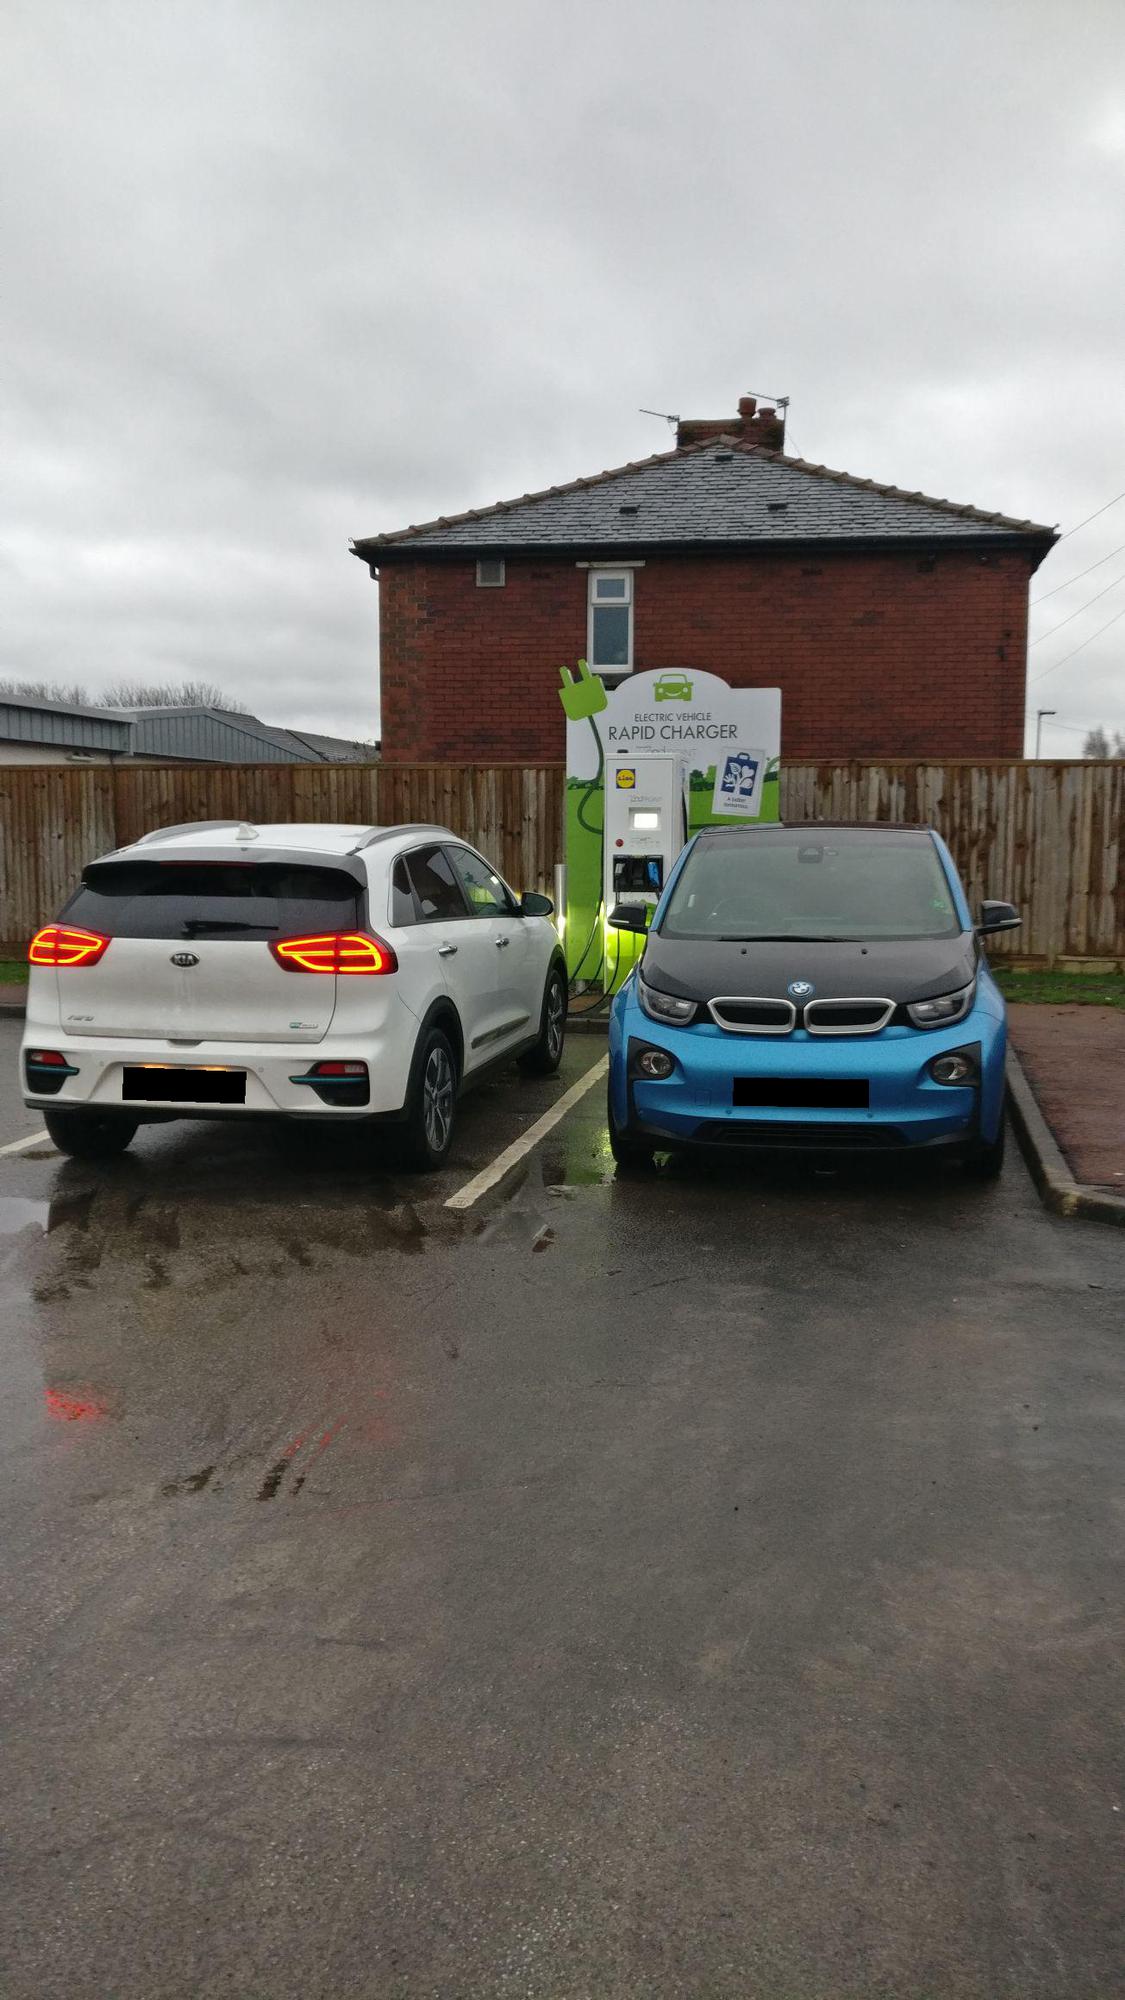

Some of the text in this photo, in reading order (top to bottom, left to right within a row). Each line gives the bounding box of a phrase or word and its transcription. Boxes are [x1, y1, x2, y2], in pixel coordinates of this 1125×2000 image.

[634, 712, 712, 722] ELECTRIC VEHICLE
[608, 724, 738, 740] RAPID CHARGER
